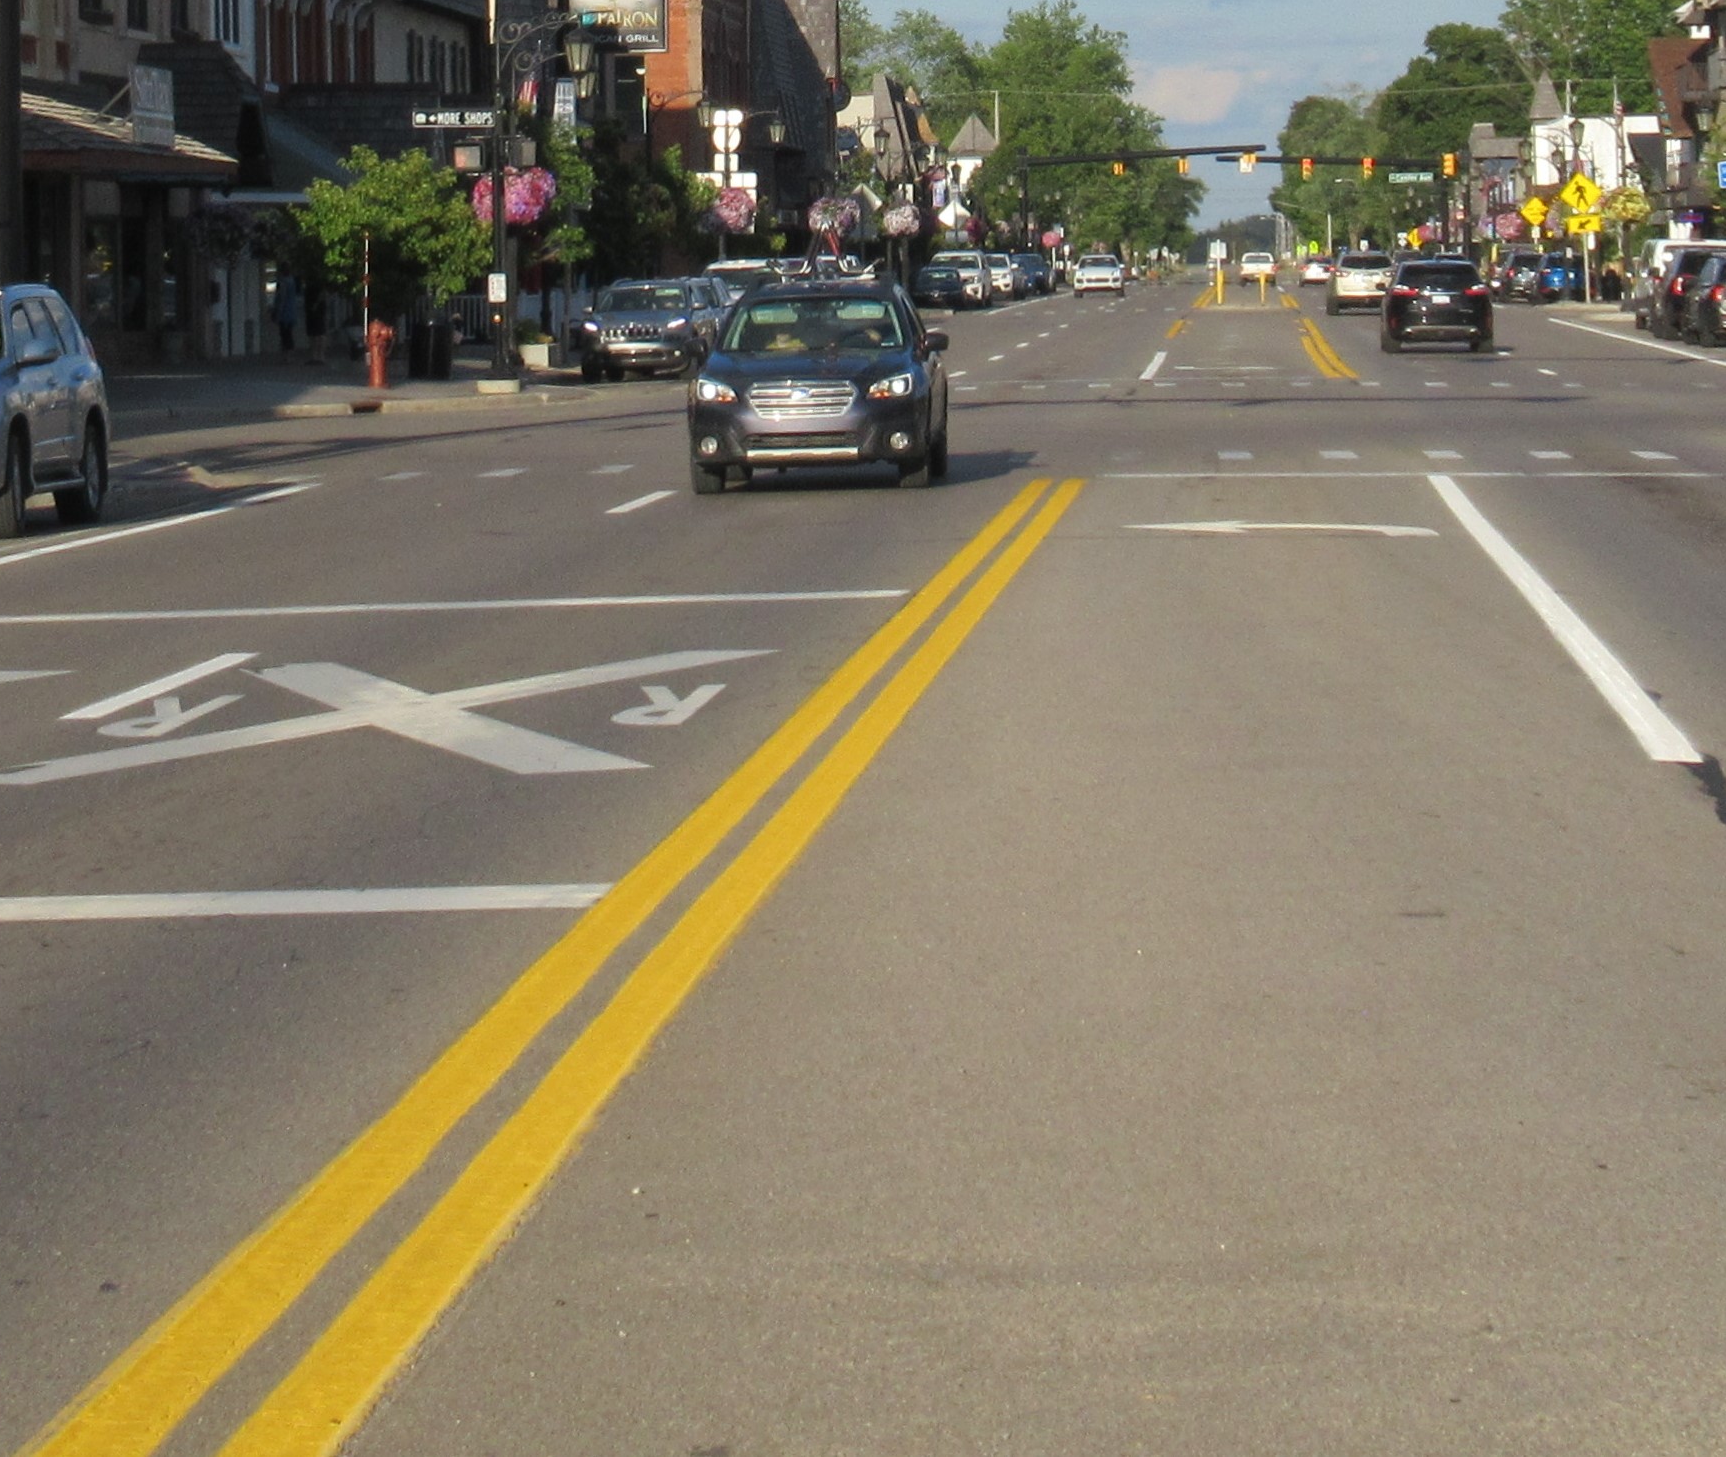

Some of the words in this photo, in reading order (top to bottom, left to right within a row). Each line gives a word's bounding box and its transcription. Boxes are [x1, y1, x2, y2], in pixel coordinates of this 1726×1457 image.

[625, 33, 659, 43] GRILL
[437, 111, 461, 125] MORE
[464, 111, 493, 125] SHOPS
